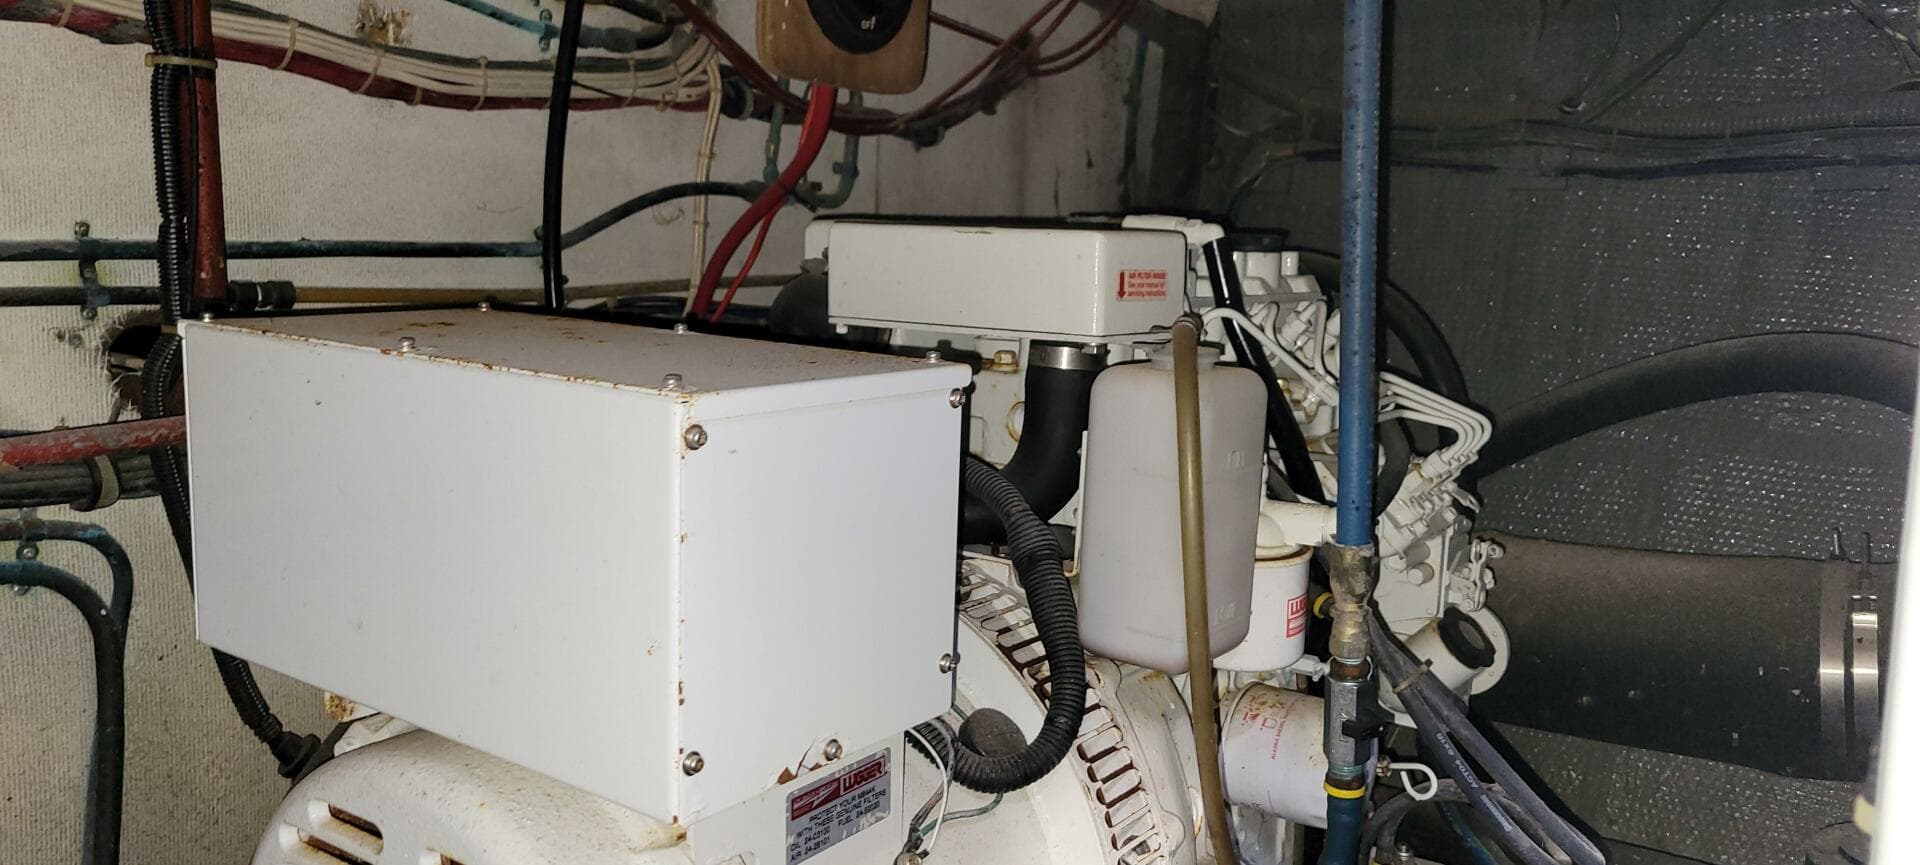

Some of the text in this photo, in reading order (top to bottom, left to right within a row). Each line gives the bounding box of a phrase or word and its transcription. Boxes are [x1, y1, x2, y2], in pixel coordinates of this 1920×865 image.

[843, 760, 884, 793] LUGGER
[796, 788, 887, 838] WITH THESE GENUINE FILTERS
[809, 804, 838, 822] PROTECT
[840, 796, 857, 809] YOUR
[838, 815, 853, 827] FUEL
[790, 850, 802, 863] AIR
